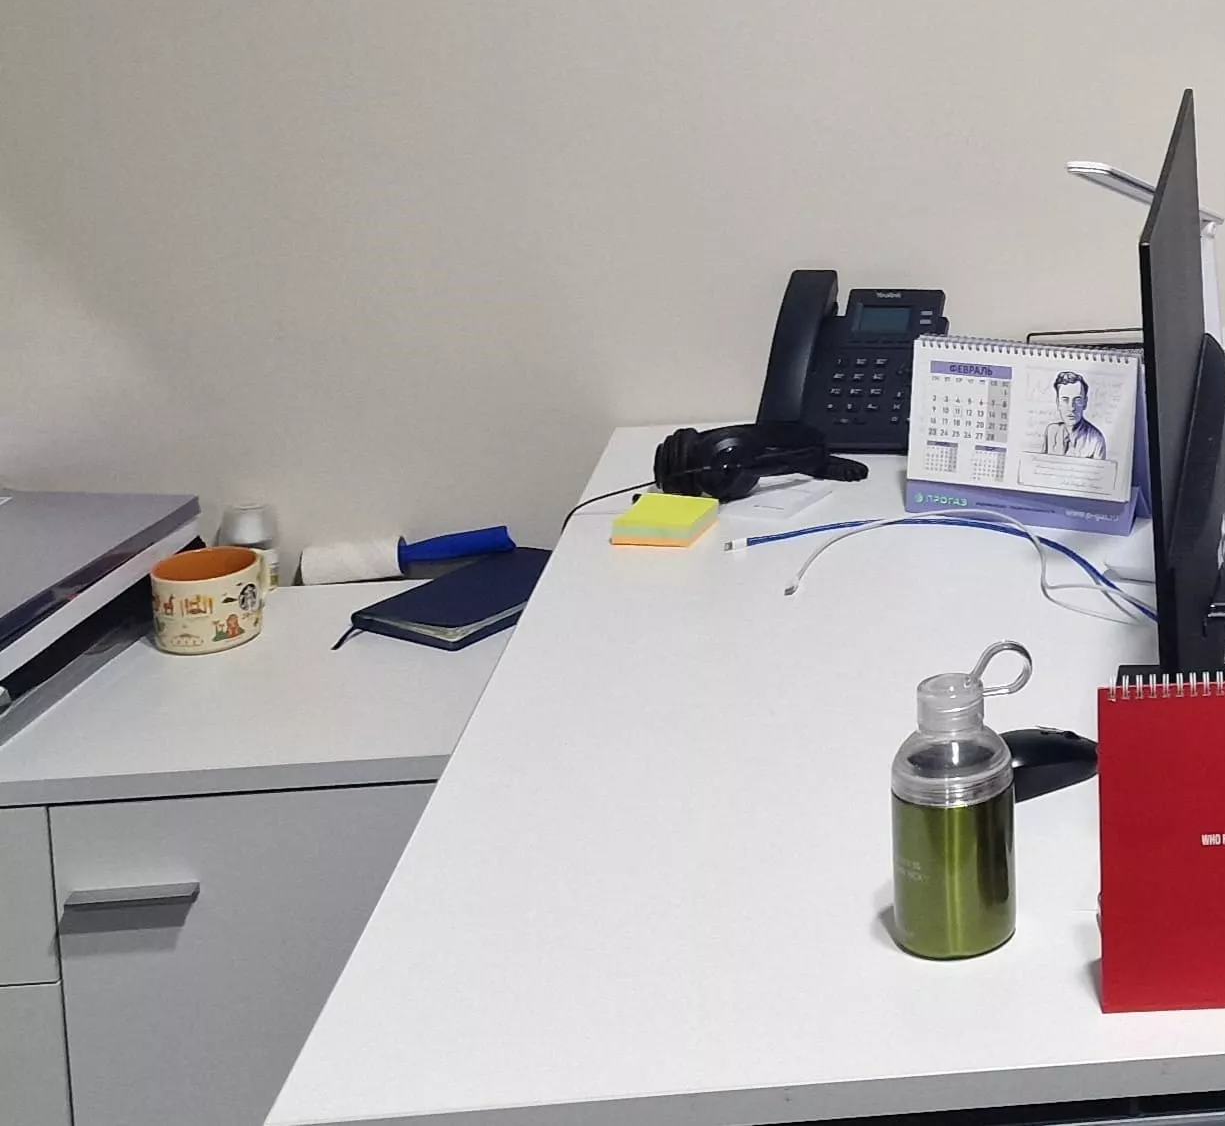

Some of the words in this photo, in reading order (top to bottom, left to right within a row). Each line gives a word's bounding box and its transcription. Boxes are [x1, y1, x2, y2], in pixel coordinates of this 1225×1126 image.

[949, 364, 993, 376] ФЕВРАЛЬ
[966, 409, 972, 417] 12
[976, 421, 984, 429] 20
[928, 427, 937, 436] 23
[940, 428, 948, 436] 24
[963, 431, 971, 439] 26
[975, 432, 983, 440] 27
[986, 433, 995, 441] 28
[1201, 833, 1221, 846] WHO
